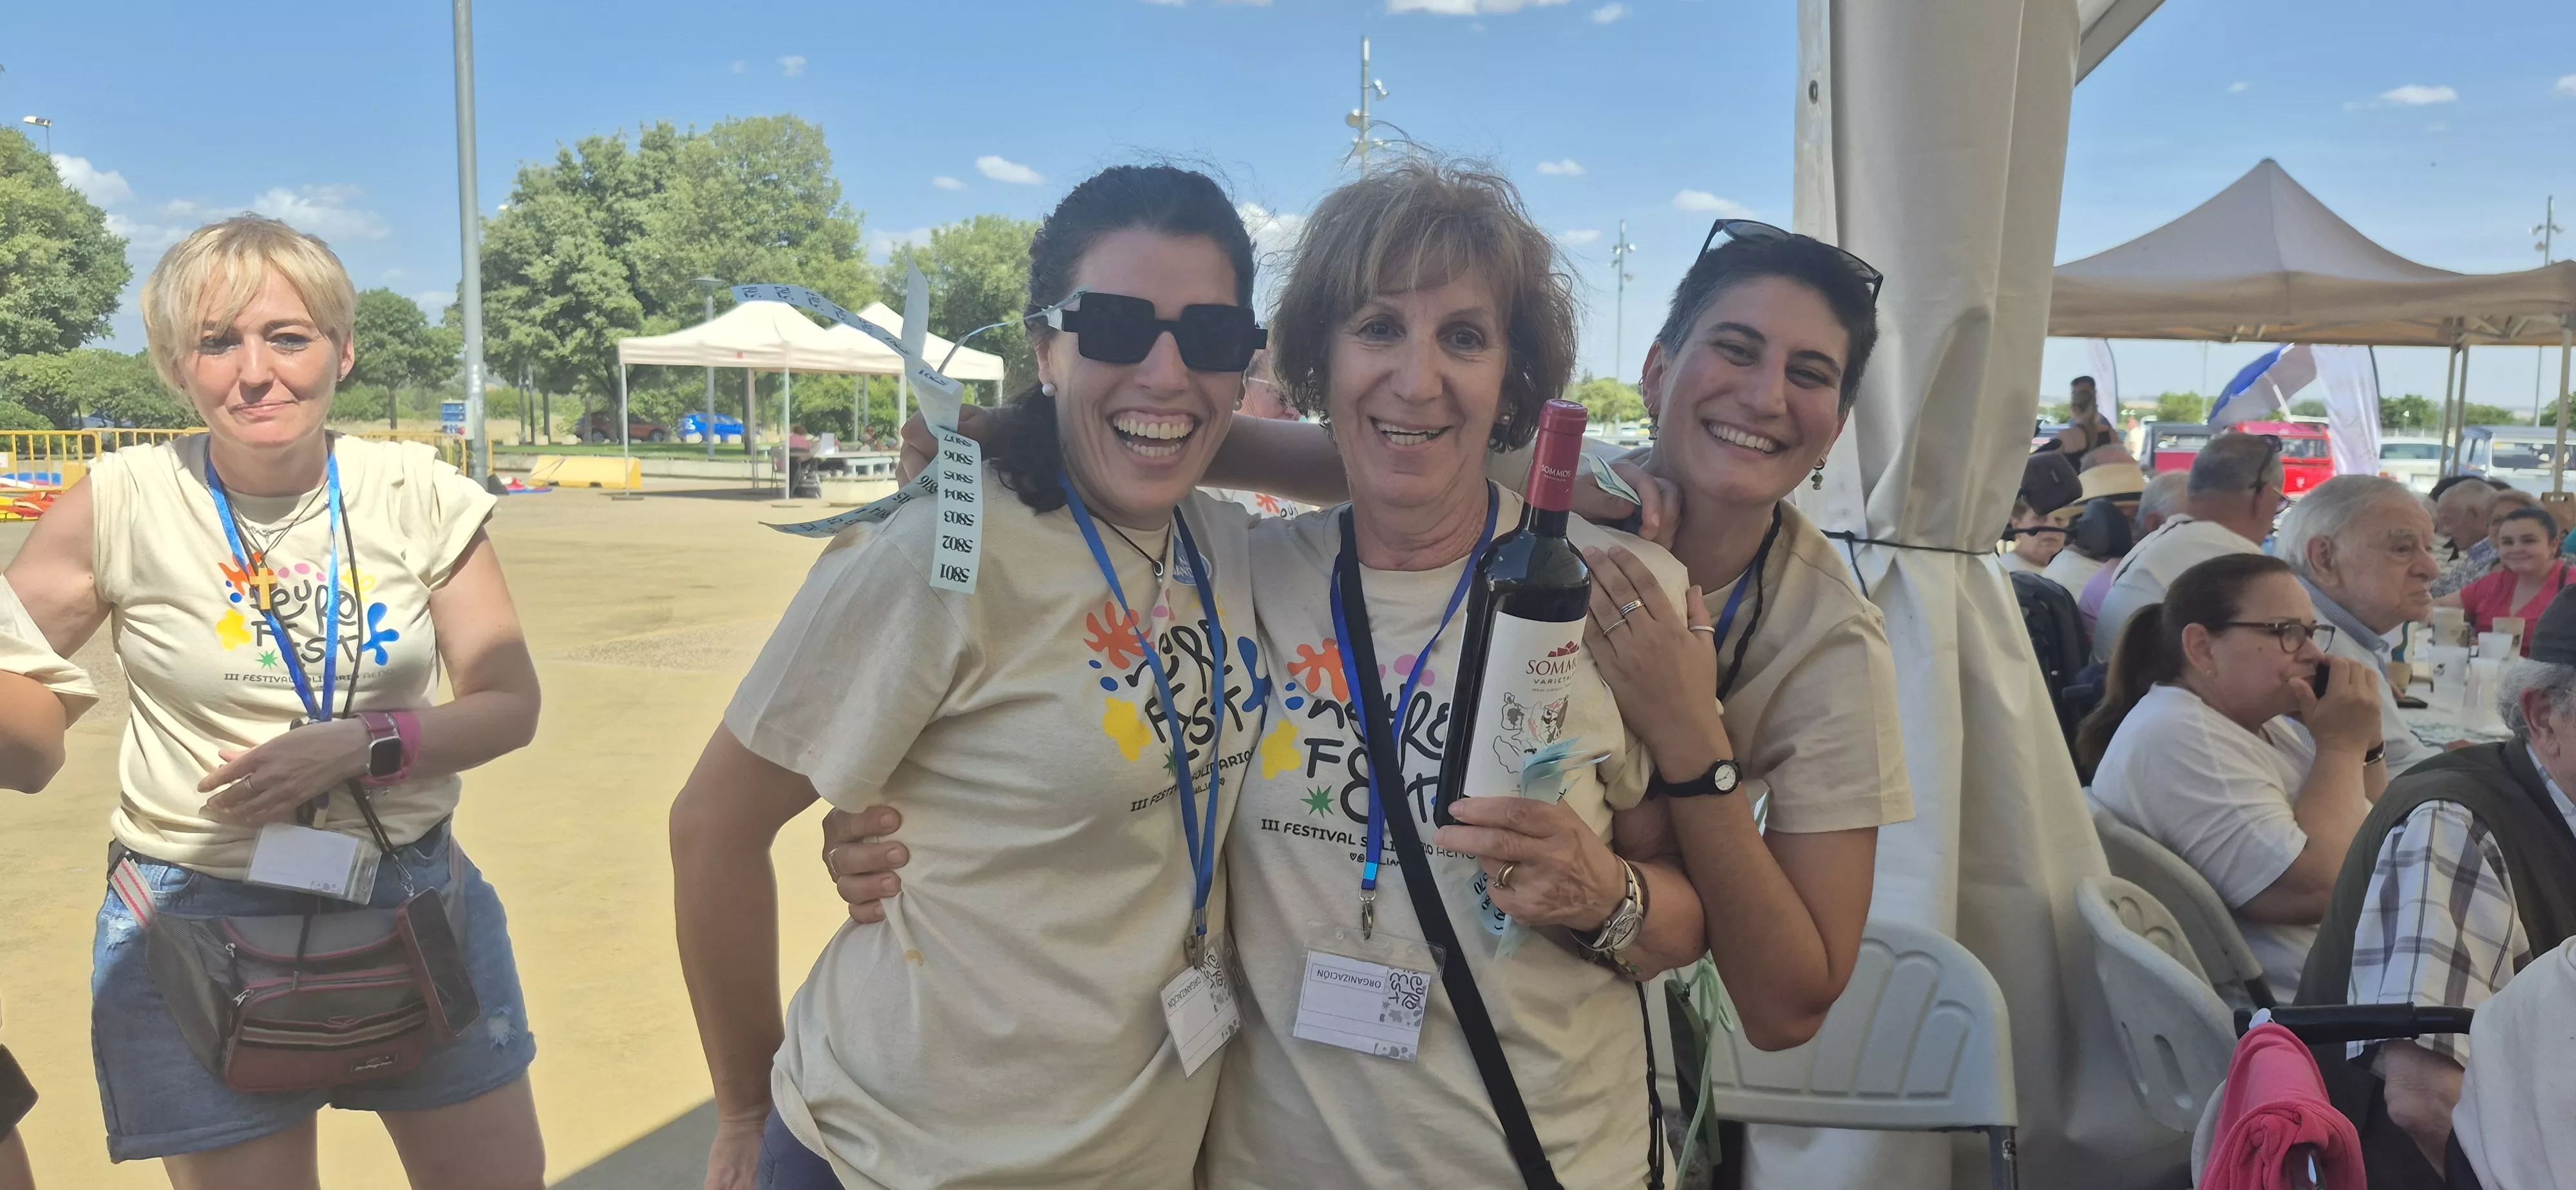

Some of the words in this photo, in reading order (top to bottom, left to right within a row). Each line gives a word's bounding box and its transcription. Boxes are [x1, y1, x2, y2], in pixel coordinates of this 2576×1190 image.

[943, 434, 972, 448] 5807
[943, 449, 974, 466] 5806
[943, 470, 974, 484] 5805
[1540, 464, 1571, 478] SOMMOS
[916, 475, 938, 494] 816
[943, 488, 975, 503] 5804
[943, 510, 974, 527] 5803
[942, 534, 974, 554] 5802
[940, 563, 971, 583] 5801
[251, 620, 359, 666] FST
[1130, 798, 1149, 813] III
[1261, 818, 1280, 832] III
[1283, 822, 1356, 846] FESTIVAL
[1360, 836, 1434, 856] SLIIO
[1316, 968, 1382, 989] ORGANIZACIÓN
[1167, 976, 1202, 1009] ORGANIZACIÓN
